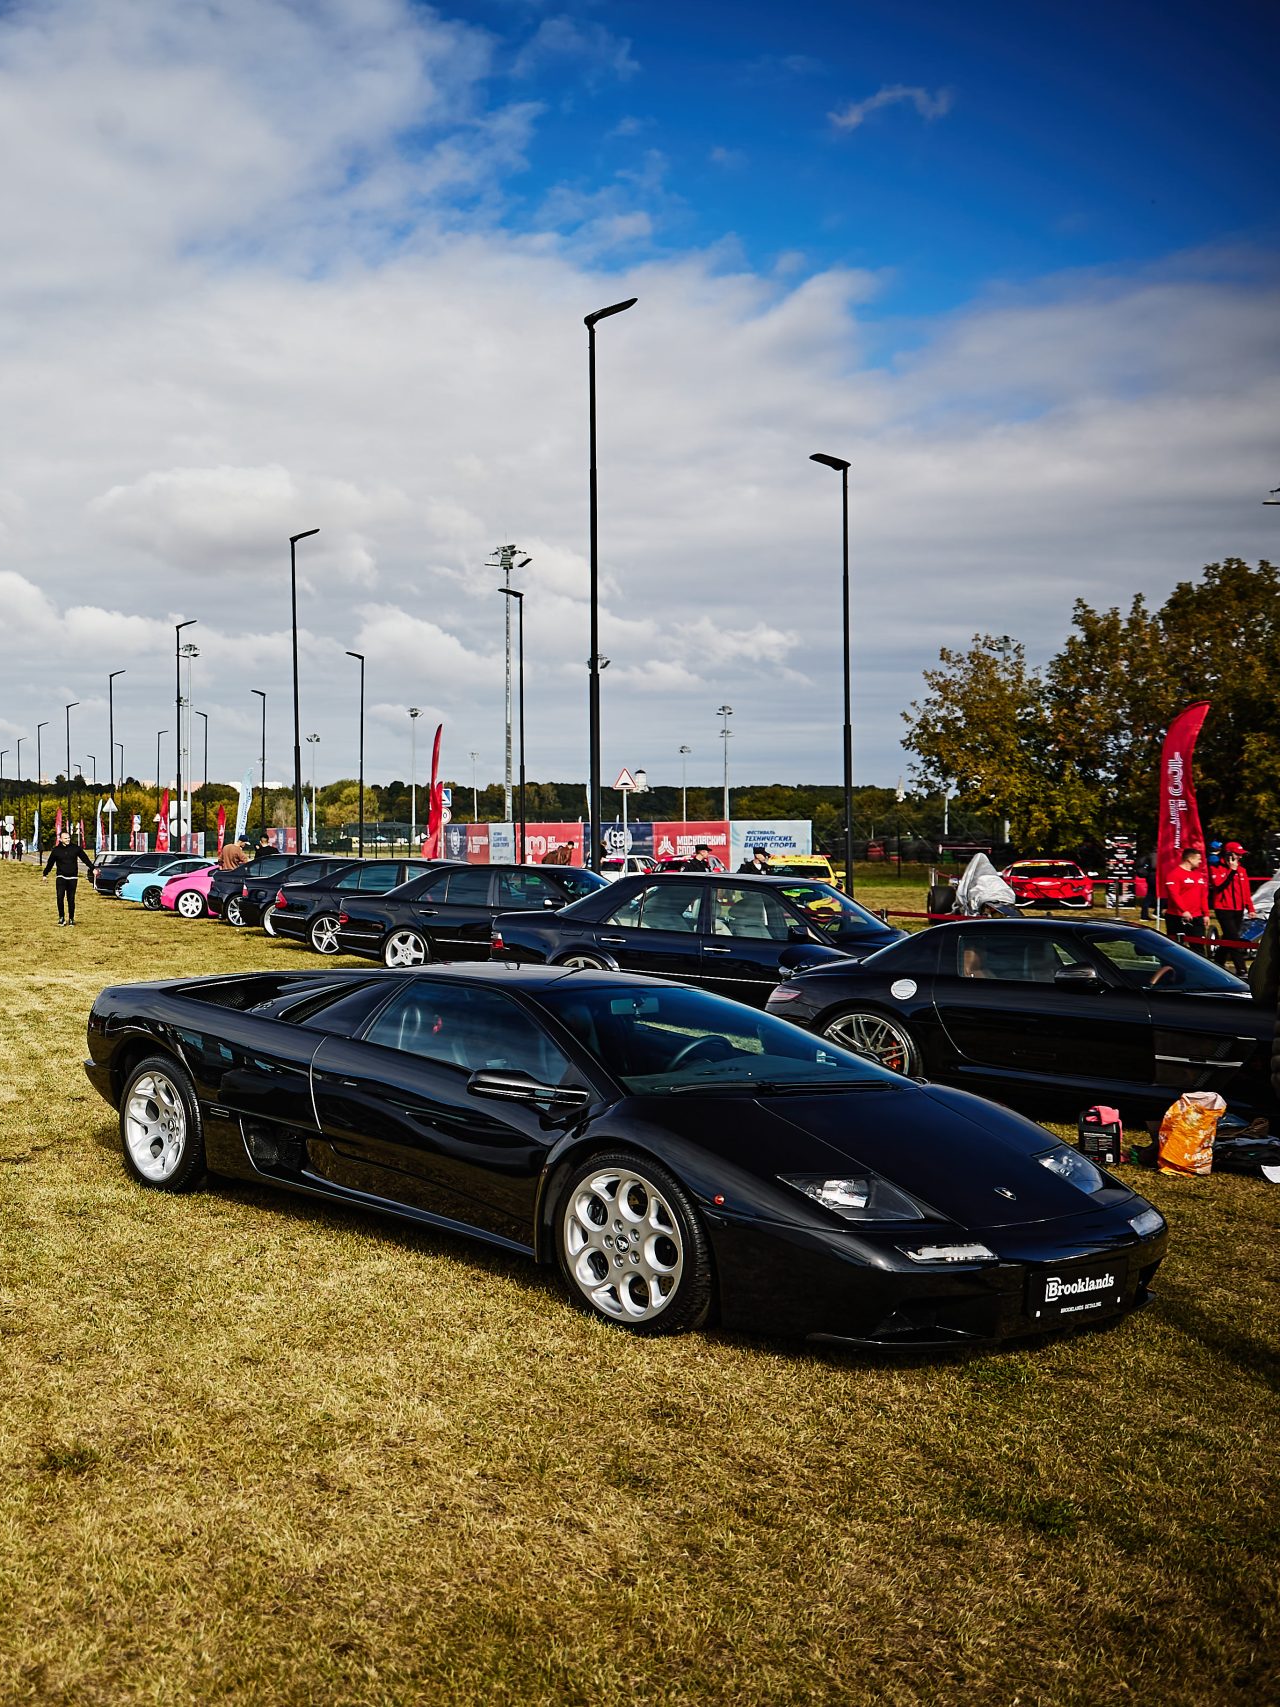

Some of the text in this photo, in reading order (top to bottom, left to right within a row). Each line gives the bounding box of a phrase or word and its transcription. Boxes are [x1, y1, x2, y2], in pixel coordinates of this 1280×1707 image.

[676, 833, 727, 845] МОСКОВСКИЙ
[676, 845, 697, 855] СПОР
[1045, 1273, 1115, 1302] Brooklands
[1060, 1304, 1084, 1314] BROOKLANDS
